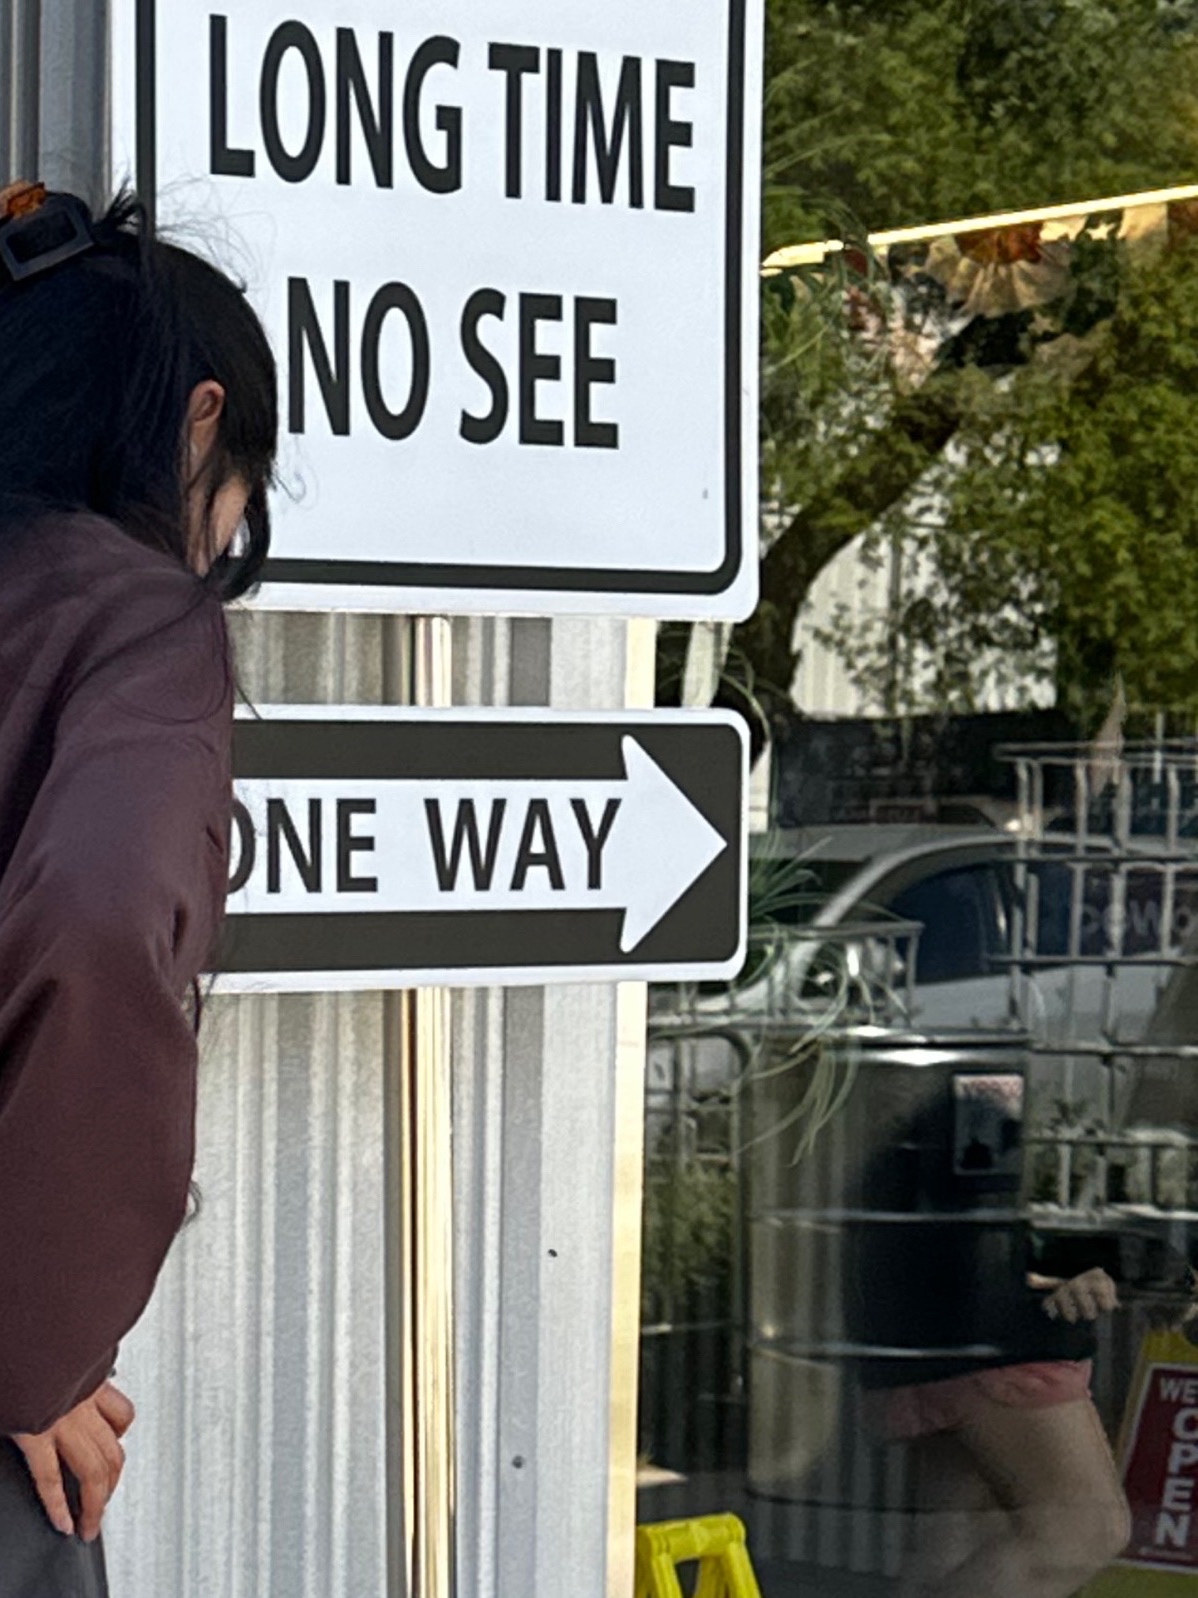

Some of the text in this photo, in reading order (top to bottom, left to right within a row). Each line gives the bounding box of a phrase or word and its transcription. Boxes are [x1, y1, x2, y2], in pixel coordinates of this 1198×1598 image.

[209, 14, 695, 213] LONG TIME
[287, 276, 619, 450] NO SEE
[424, 797, 621, 892] WAY
